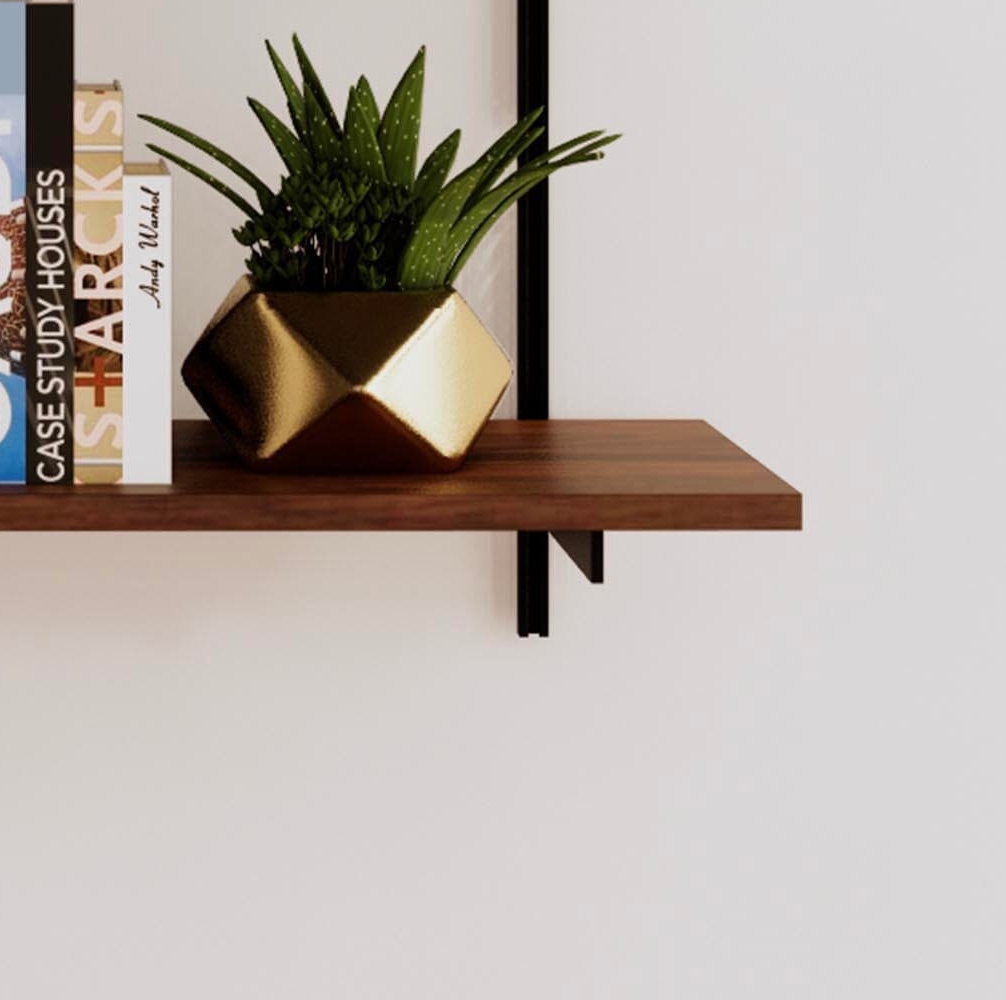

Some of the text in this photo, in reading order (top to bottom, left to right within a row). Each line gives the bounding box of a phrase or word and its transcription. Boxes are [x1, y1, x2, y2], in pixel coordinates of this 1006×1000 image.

[37, 168, 65, 483] CASE STUDY HOUSES
[138, 186, 164, 310] Andy Warhol
